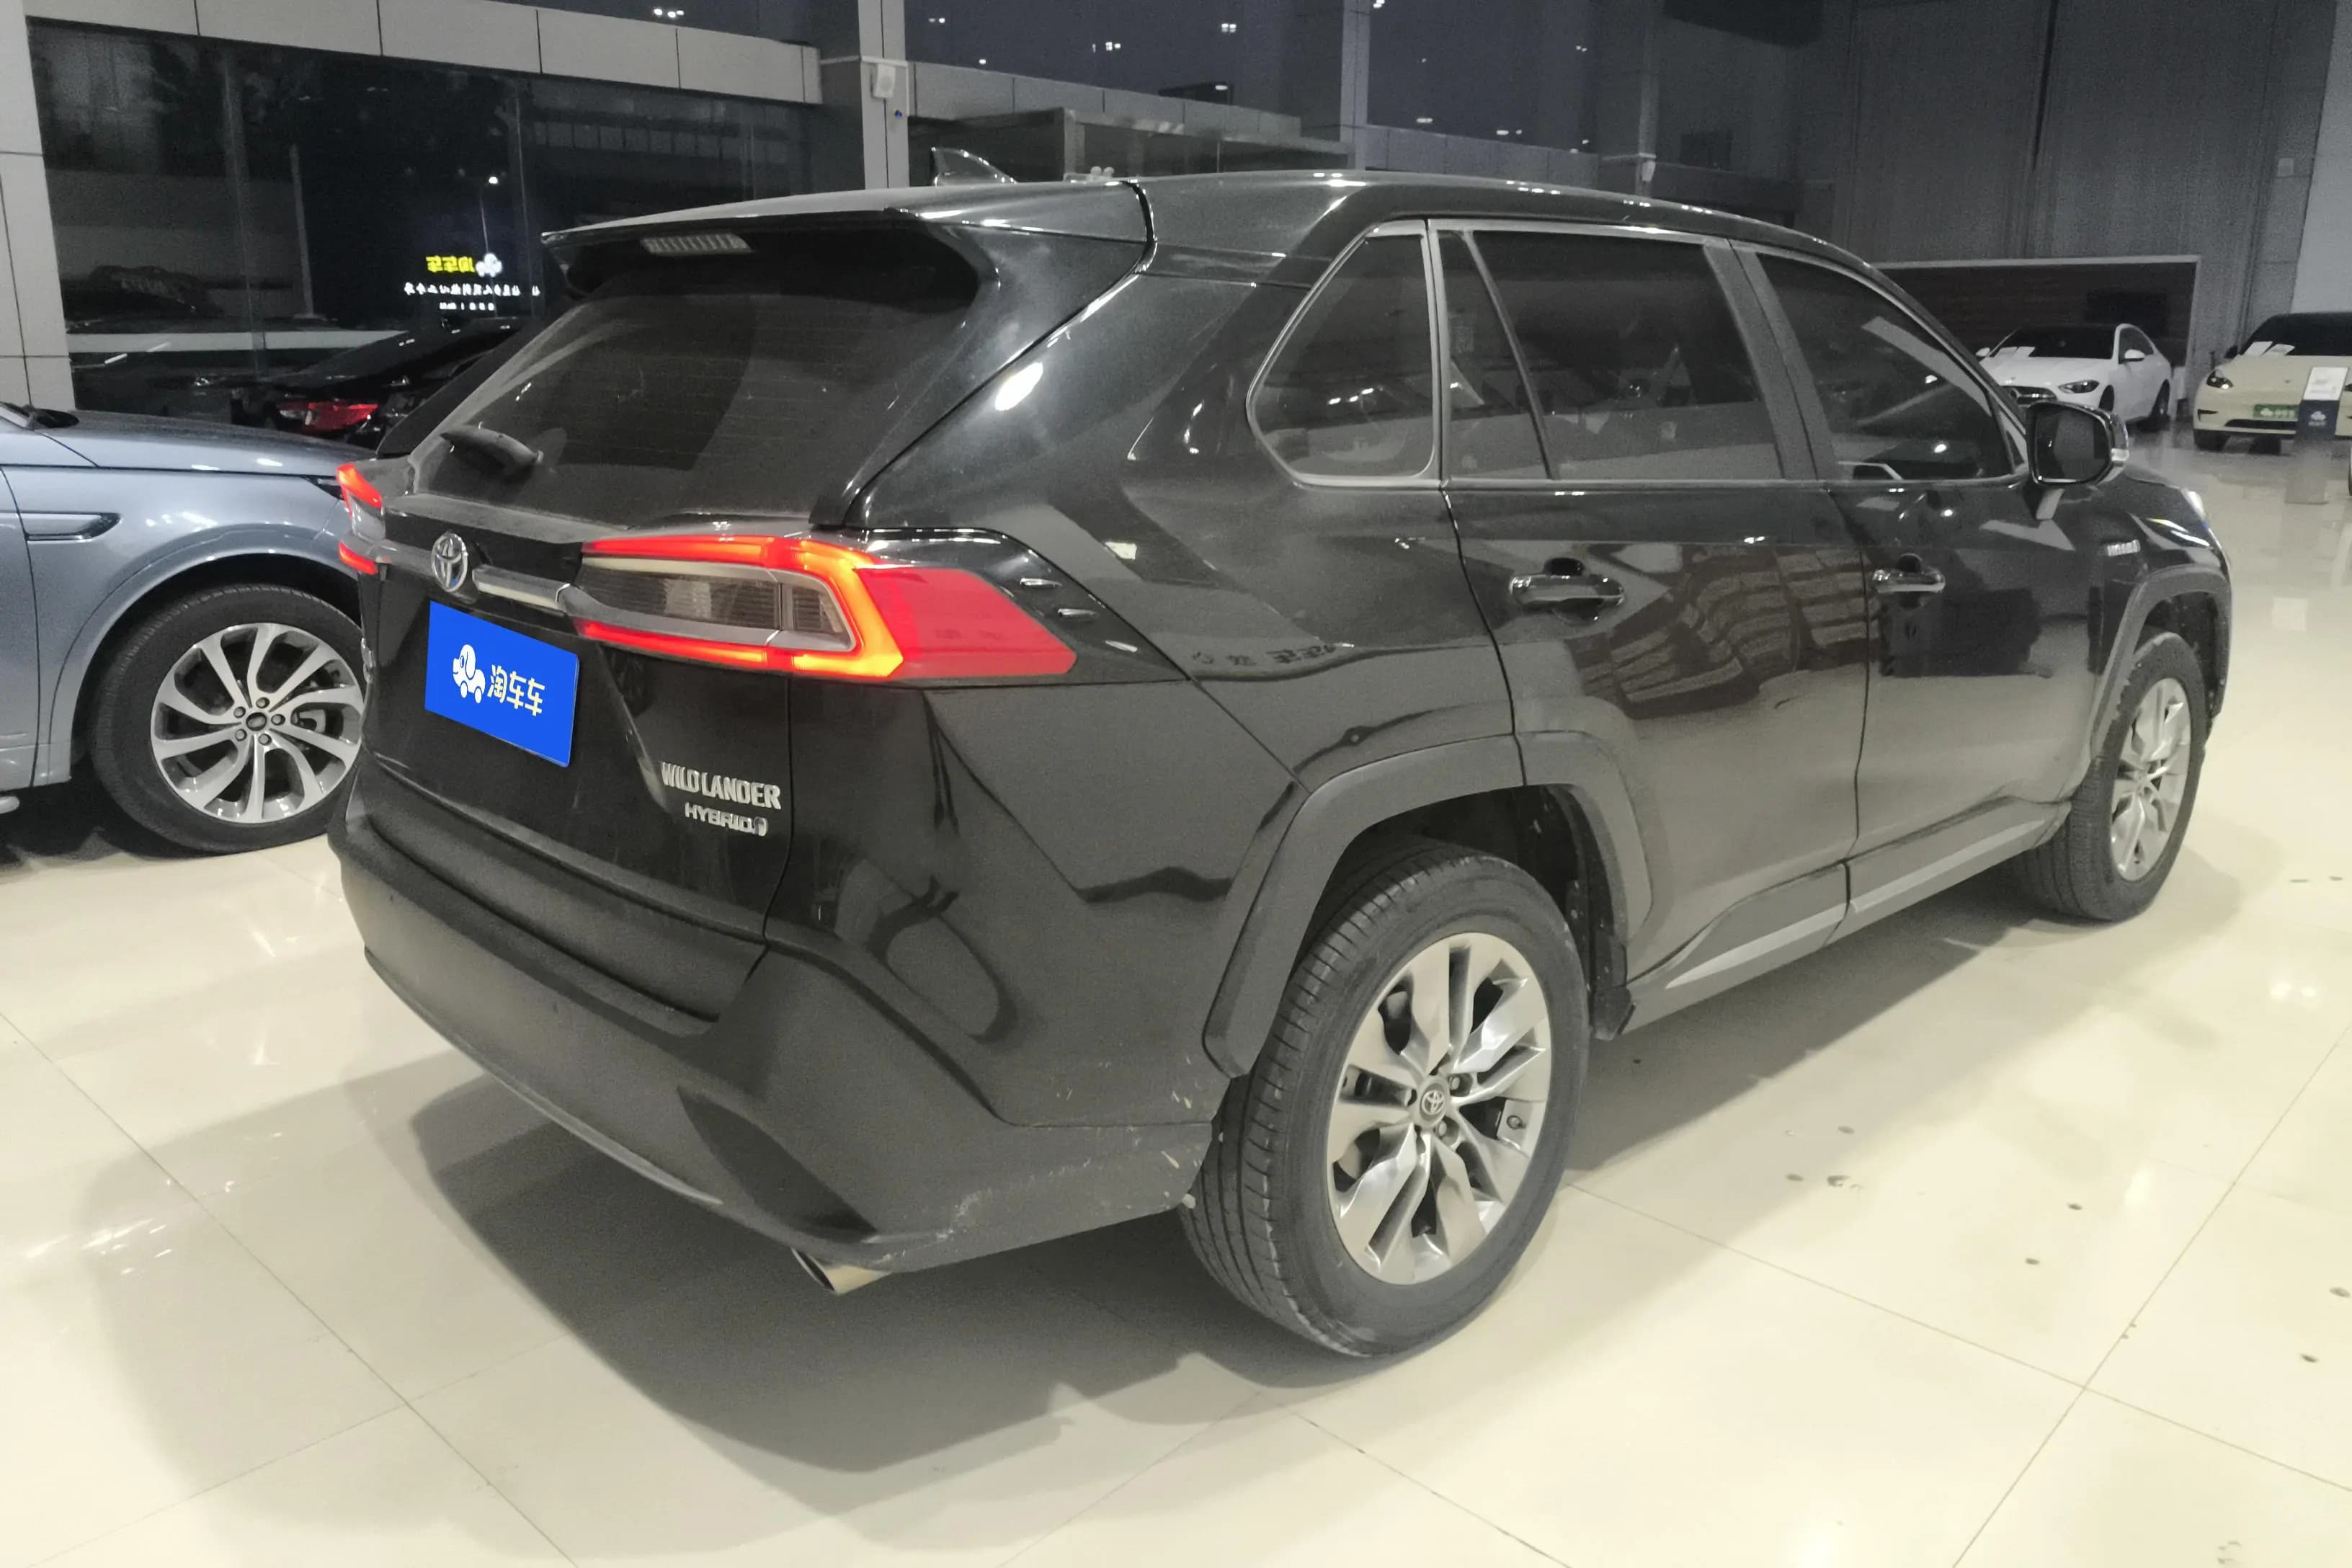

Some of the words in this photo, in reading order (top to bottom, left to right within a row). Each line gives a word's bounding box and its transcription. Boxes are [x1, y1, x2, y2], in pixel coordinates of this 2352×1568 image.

[486, 663, 545, 717] 淘车车
[685, 801, 756, 835] HYBRID
